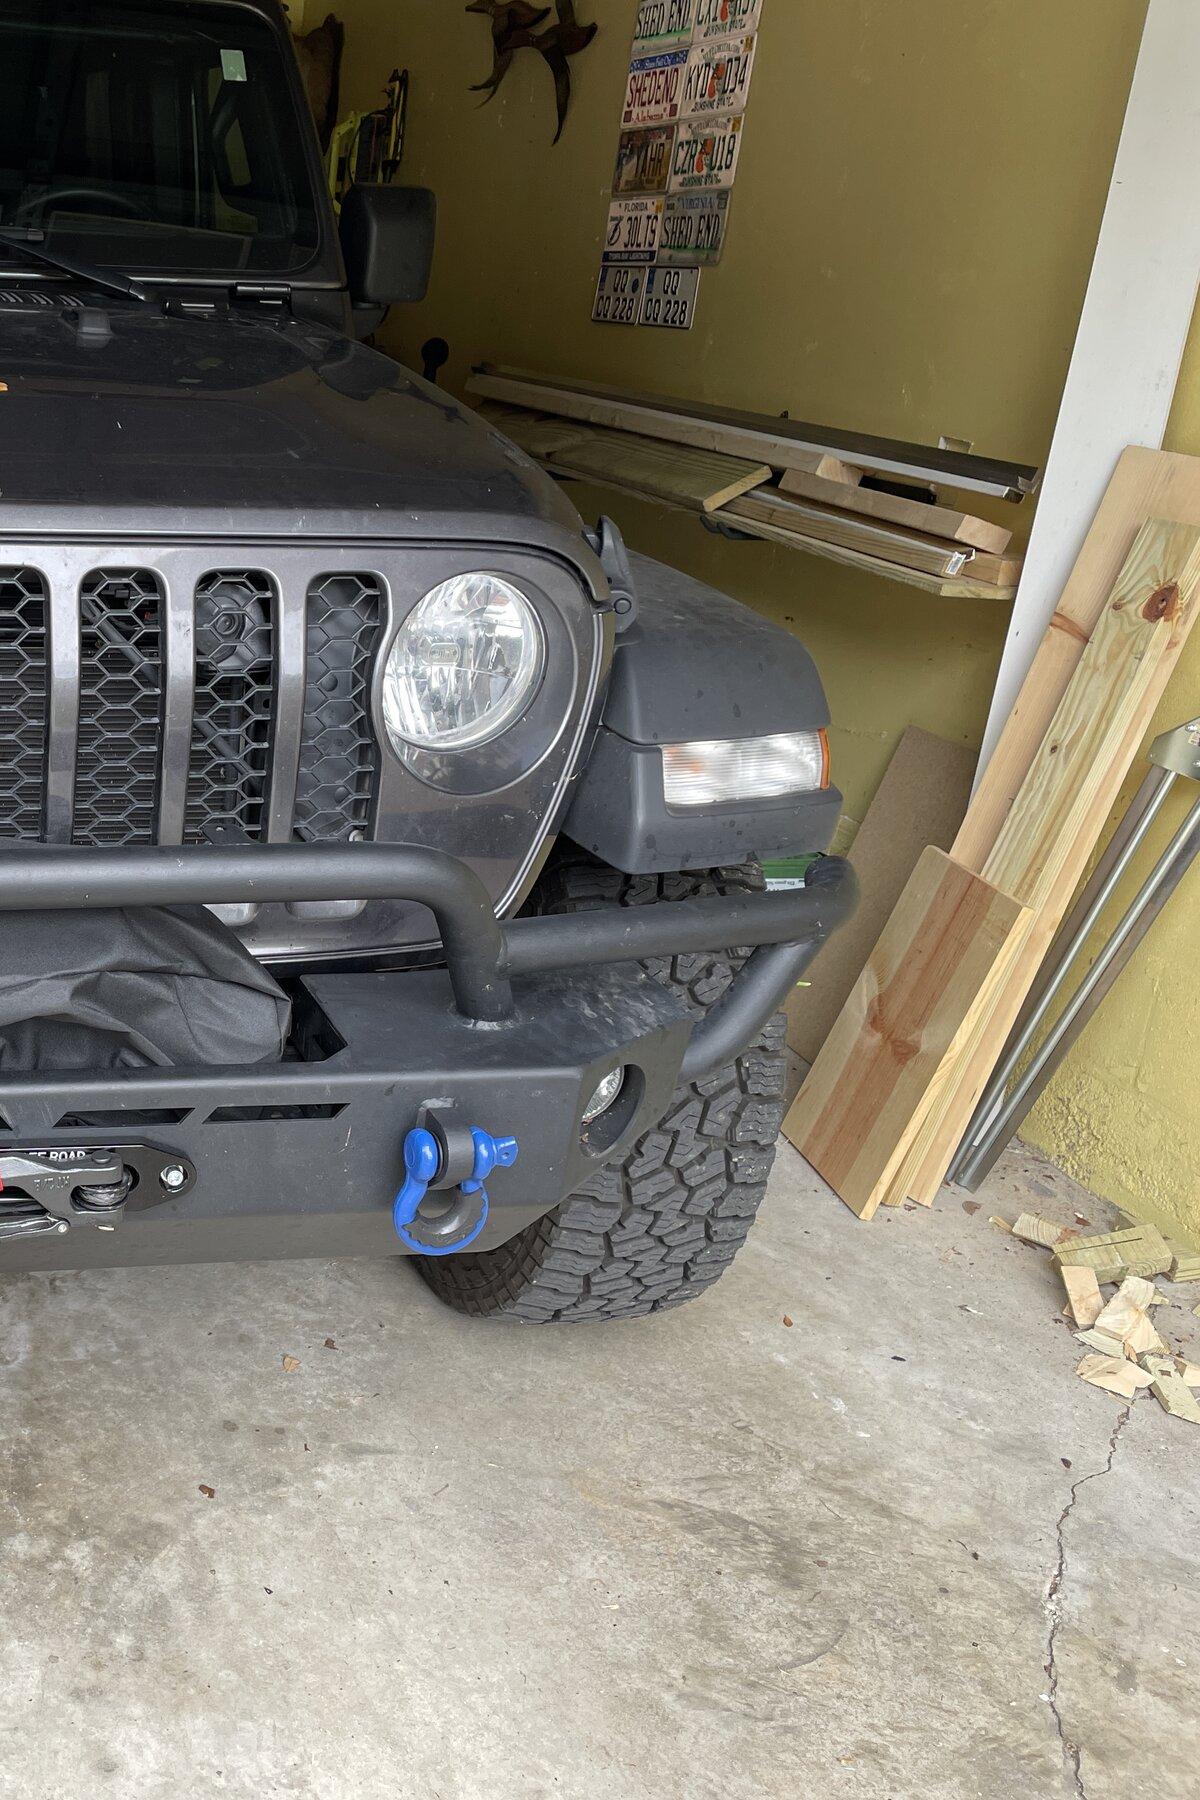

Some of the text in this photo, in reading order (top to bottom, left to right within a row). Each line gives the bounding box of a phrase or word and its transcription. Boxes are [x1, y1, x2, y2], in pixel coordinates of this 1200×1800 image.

[634, 4, 664, 40] SHED
[626, 66, 679, 108] SHEDEND
[624, 202, 648, 212] FLORIDA
[660, 212, 720, 249] SHED END
[663, 270, 680, 295] QQ
[611, 296, 635, 321] 228
[645, 298, 688, 325] CQ 228
